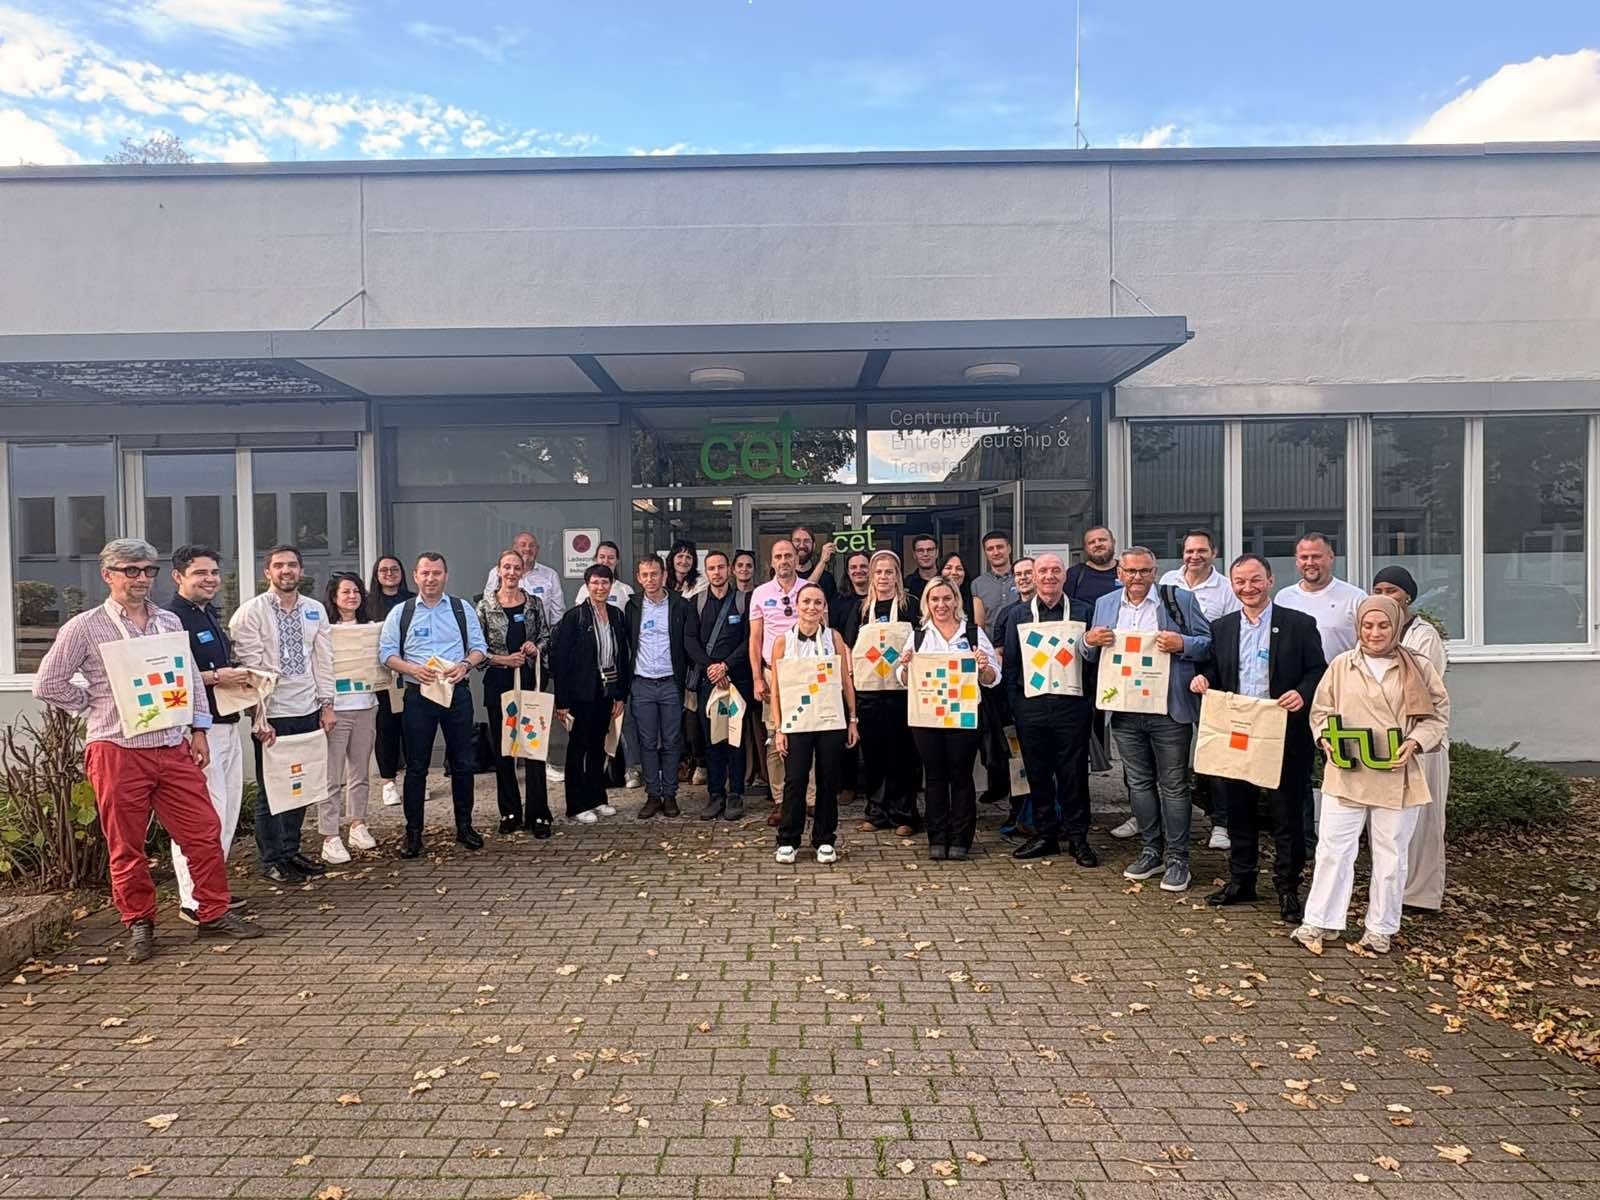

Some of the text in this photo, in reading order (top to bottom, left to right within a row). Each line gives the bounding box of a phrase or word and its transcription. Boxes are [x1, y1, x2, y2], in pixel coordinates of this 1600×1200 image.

[890, 407, 1000, 426] Centrum für
[701, 410, 809, 480] cet
[891, 430, 1071, 450] Entrepreneurship &
[891, 457, 967, 474] Transfer
[832, 525, 876, 553] cet
[1321, 714, 1402, 770] tu
